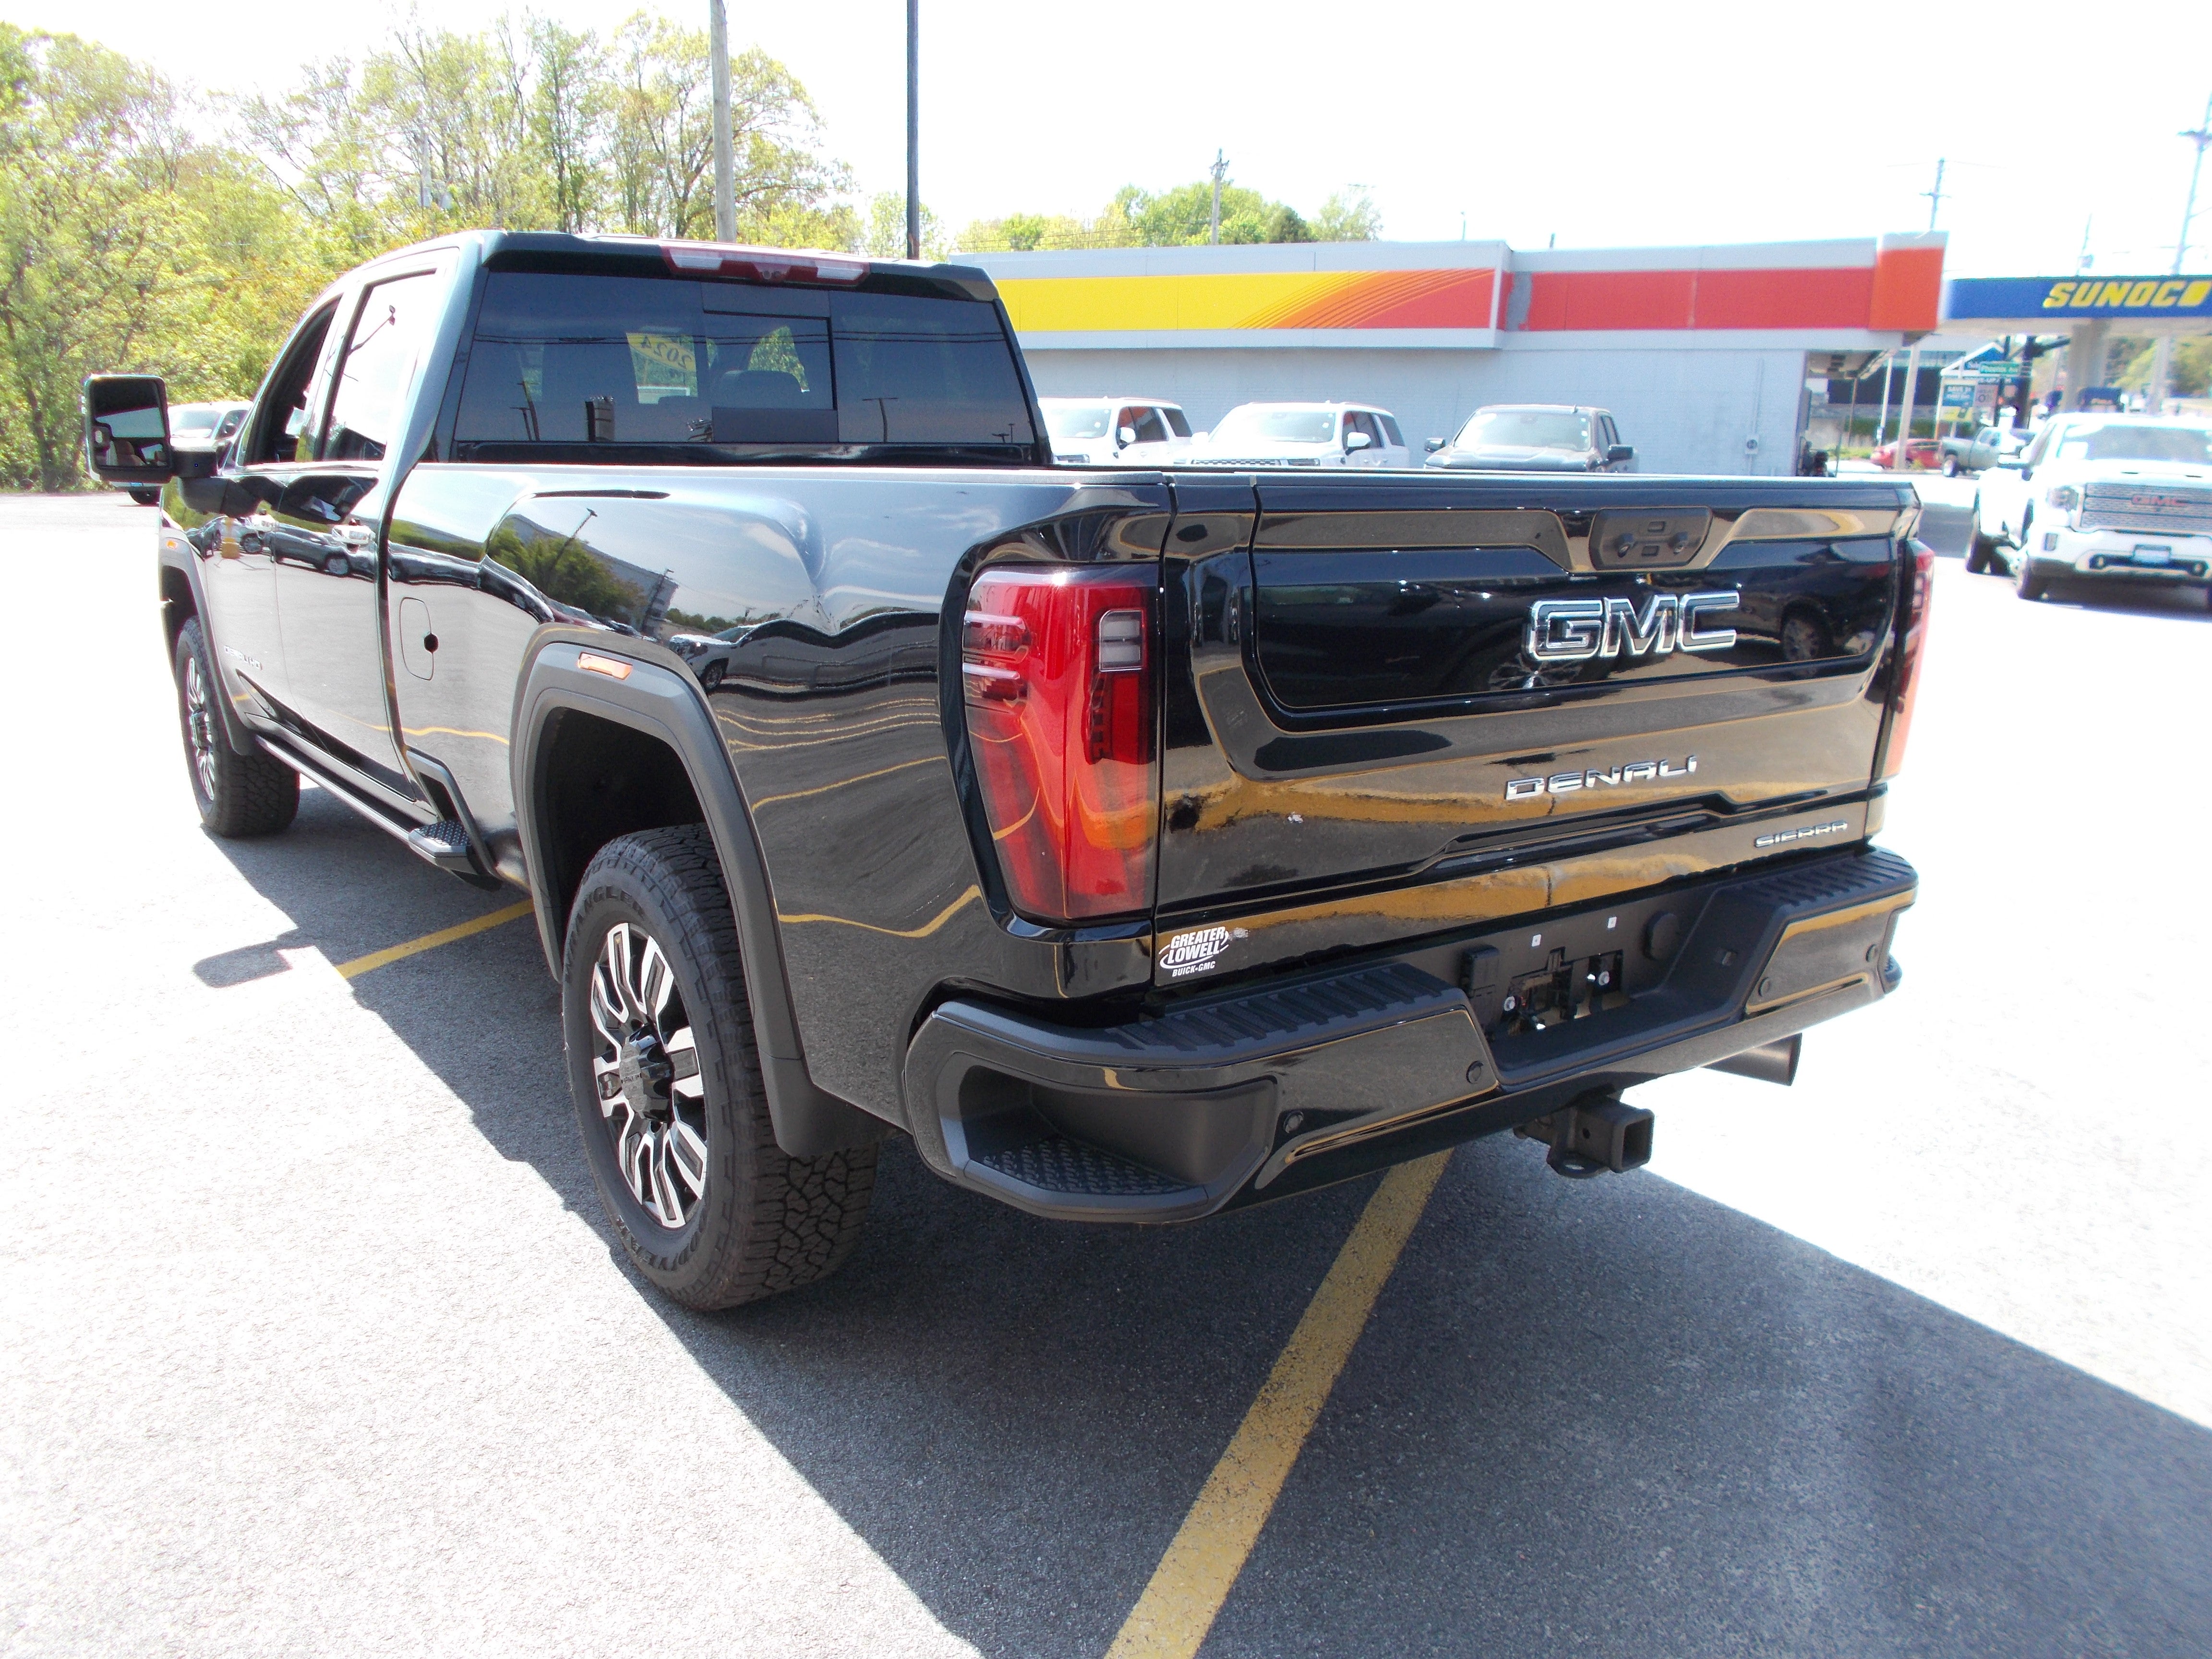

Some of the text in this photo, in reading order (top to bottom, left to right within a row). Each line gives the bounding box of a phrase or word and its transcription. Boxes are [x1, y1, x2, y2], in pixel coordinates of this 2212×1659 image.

[2043, 281, 2212, 308] SUNOCO
[1527, 590, 1740, 661] GMC
[1505, 755, 1697, 801] DENALI
[1755, 819, 1848, 848] SIERRA
[1170, 926, 1226, 949] GREATER
[1167, 940, 1220, 964] LOWELL
